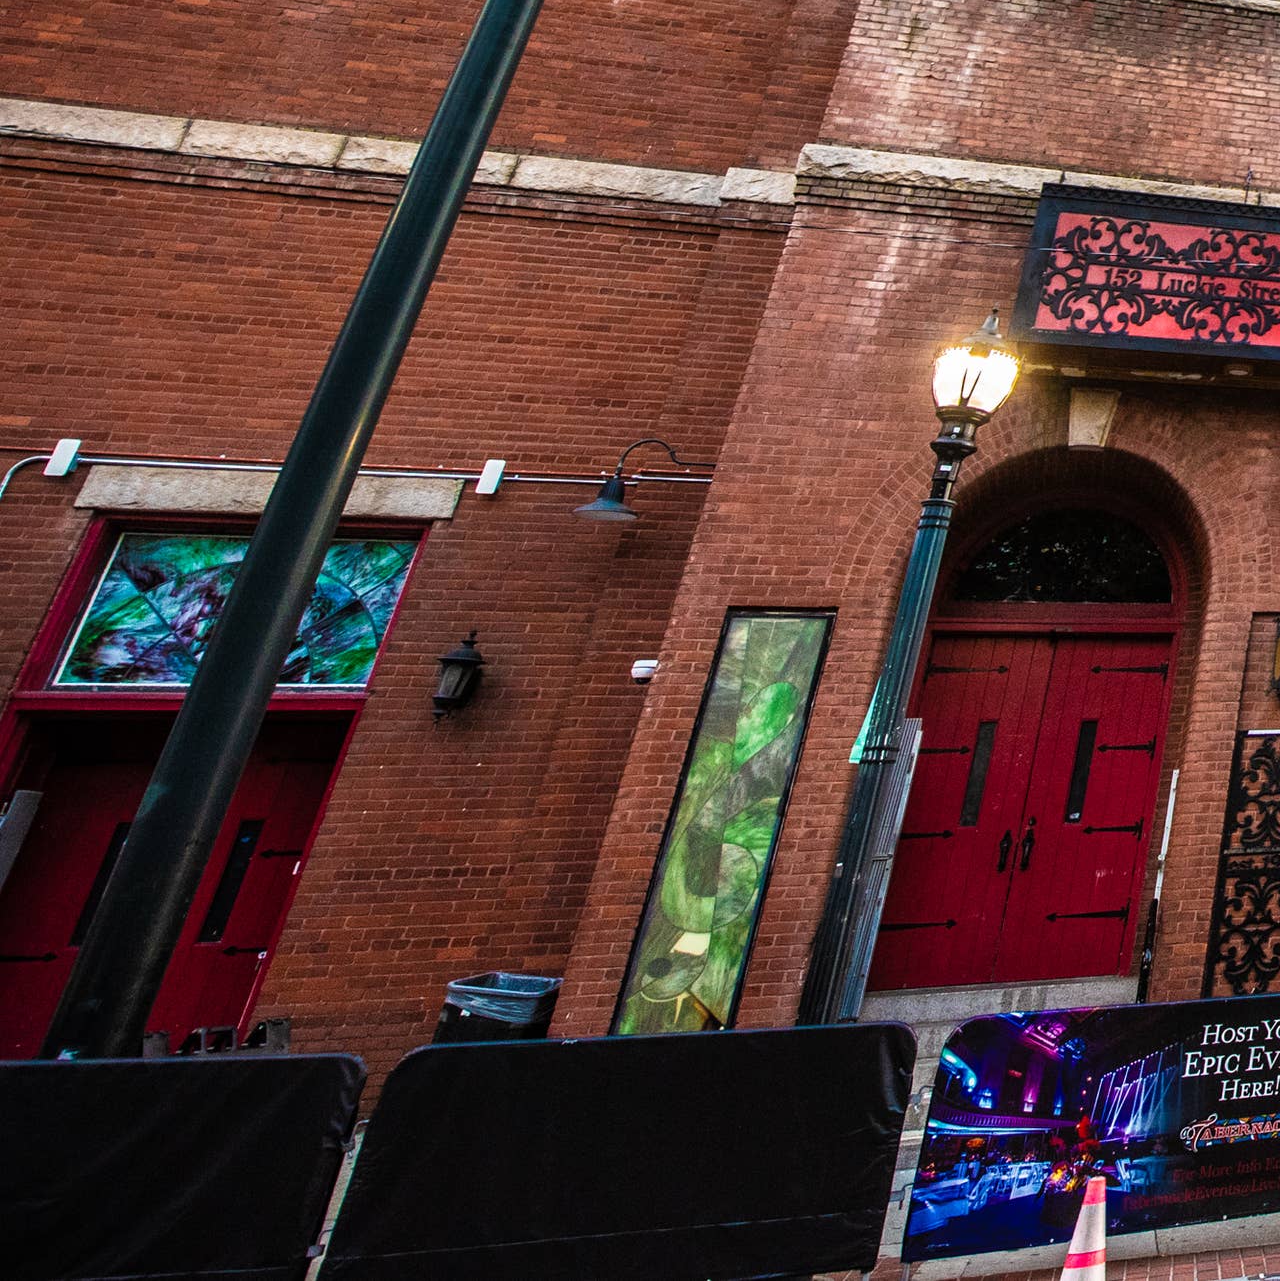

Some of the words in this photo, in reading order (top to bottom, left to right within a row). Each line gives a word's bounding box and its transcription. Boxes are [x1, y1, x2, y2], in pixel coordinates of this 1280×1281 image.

[1104, 269, 1142, 288] 152
[1157, 272, 1226, 296] Luckie
[1201, 1023, 1259, 1045] HOST
[1182, 1051, 1241, 1078] EPIC
[1219, 1075, 1280, 1101] HERE!
[1199, 1164, 1233, 1179] More
[1237, 1159, 1262, 1175] Info
